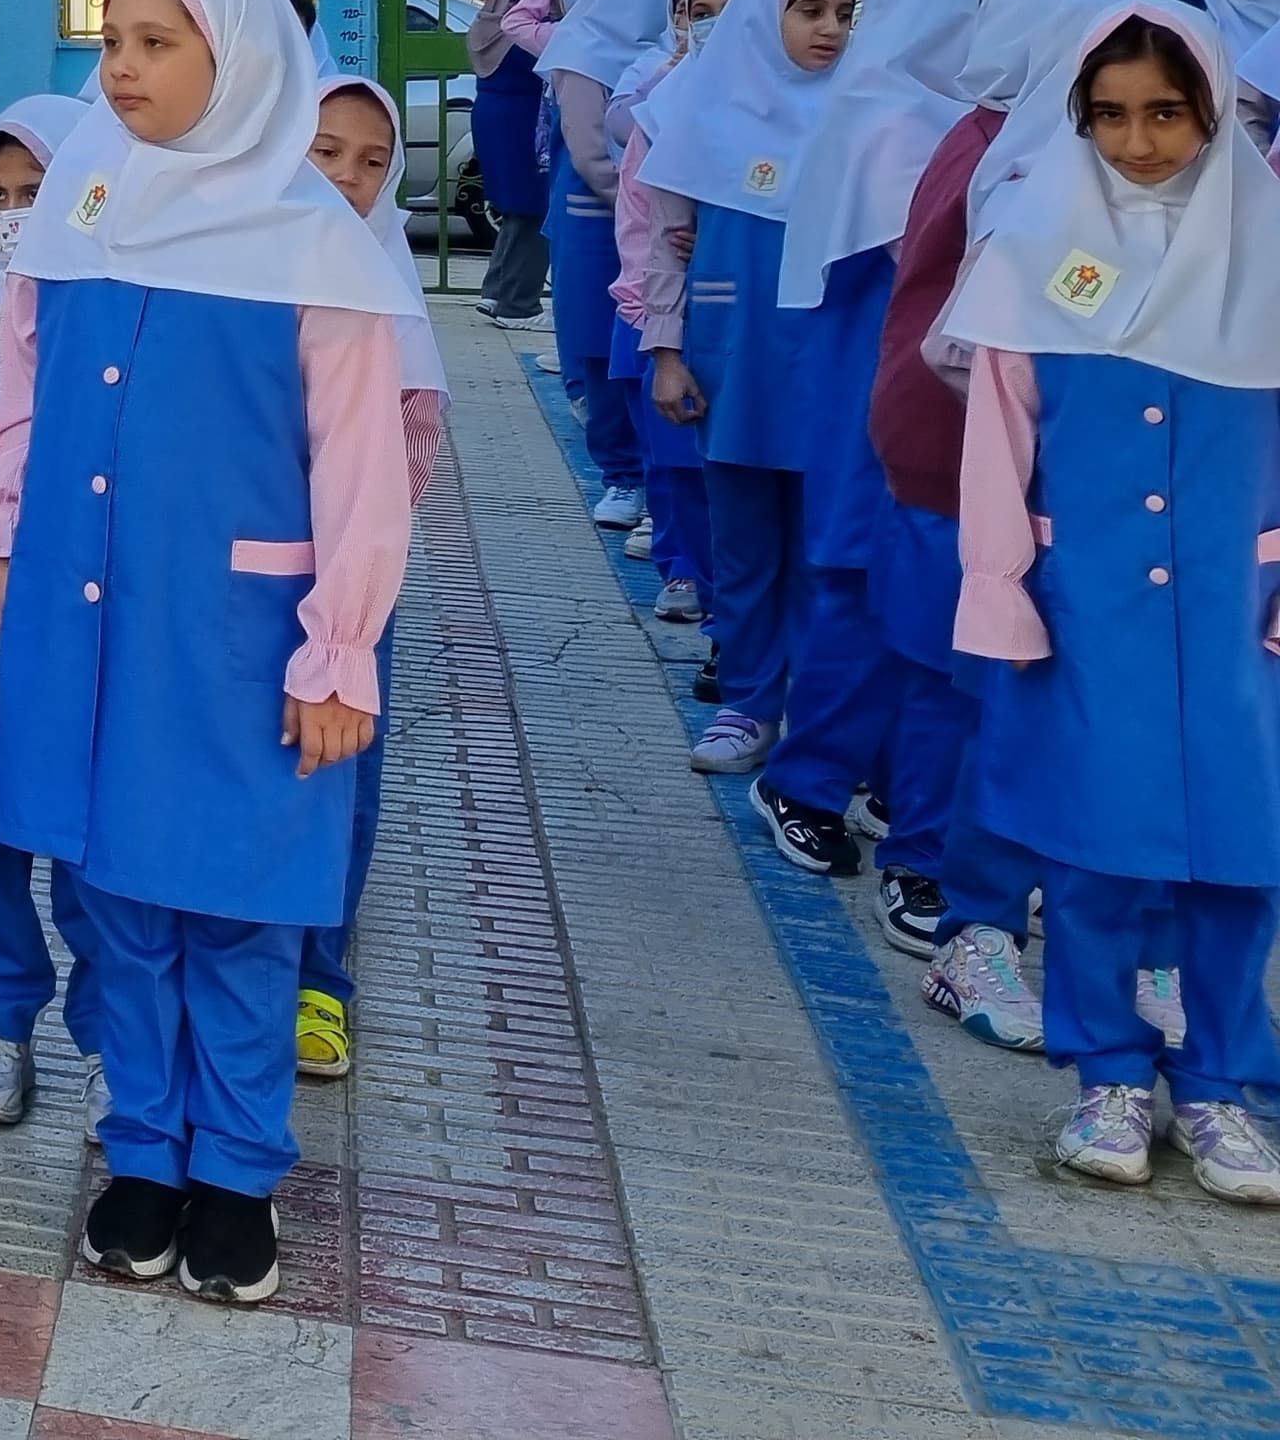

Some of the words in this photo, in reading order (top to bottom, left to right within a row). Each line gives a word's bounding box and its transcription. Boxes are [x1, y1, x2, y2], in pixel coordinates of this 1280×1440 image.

[343, 9, 360, 18] 120
[340, 31, 358, 41] 110
[339, 55, 359, 65] 100
